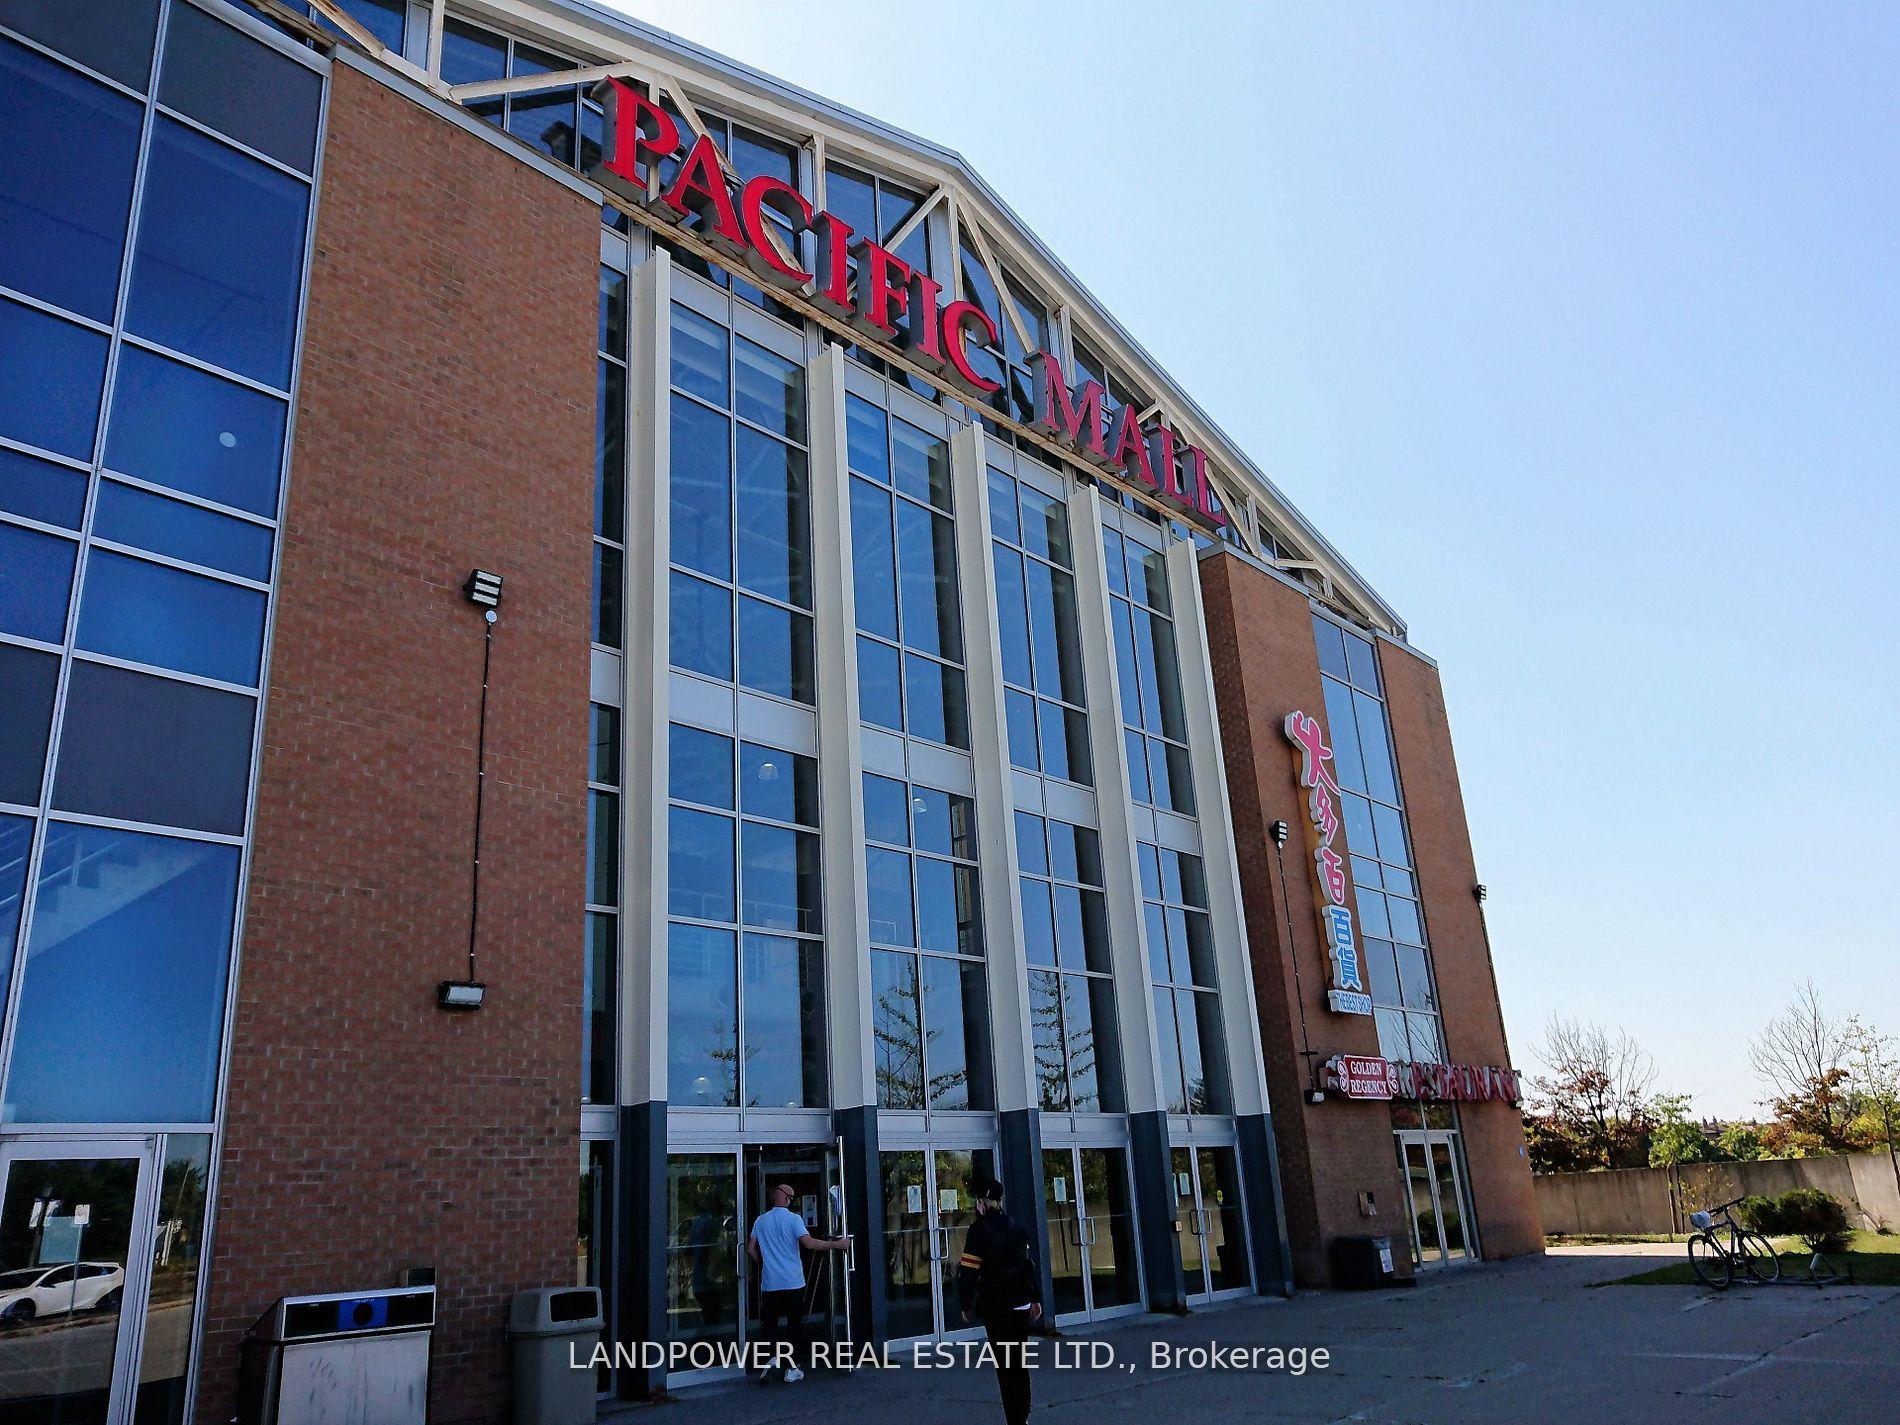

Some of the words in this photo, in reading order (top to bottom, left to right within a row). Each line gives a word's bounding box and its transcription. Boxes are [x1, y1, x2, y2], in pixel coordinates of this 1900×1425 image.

[599, 76, 1000, 394] PACIFIC
[1028, 348, 1228, 528] MALL
[1350, 1060, 1382, 1075] GOLDEN
[1350, 1079, 1387, 1095] REGENCY
